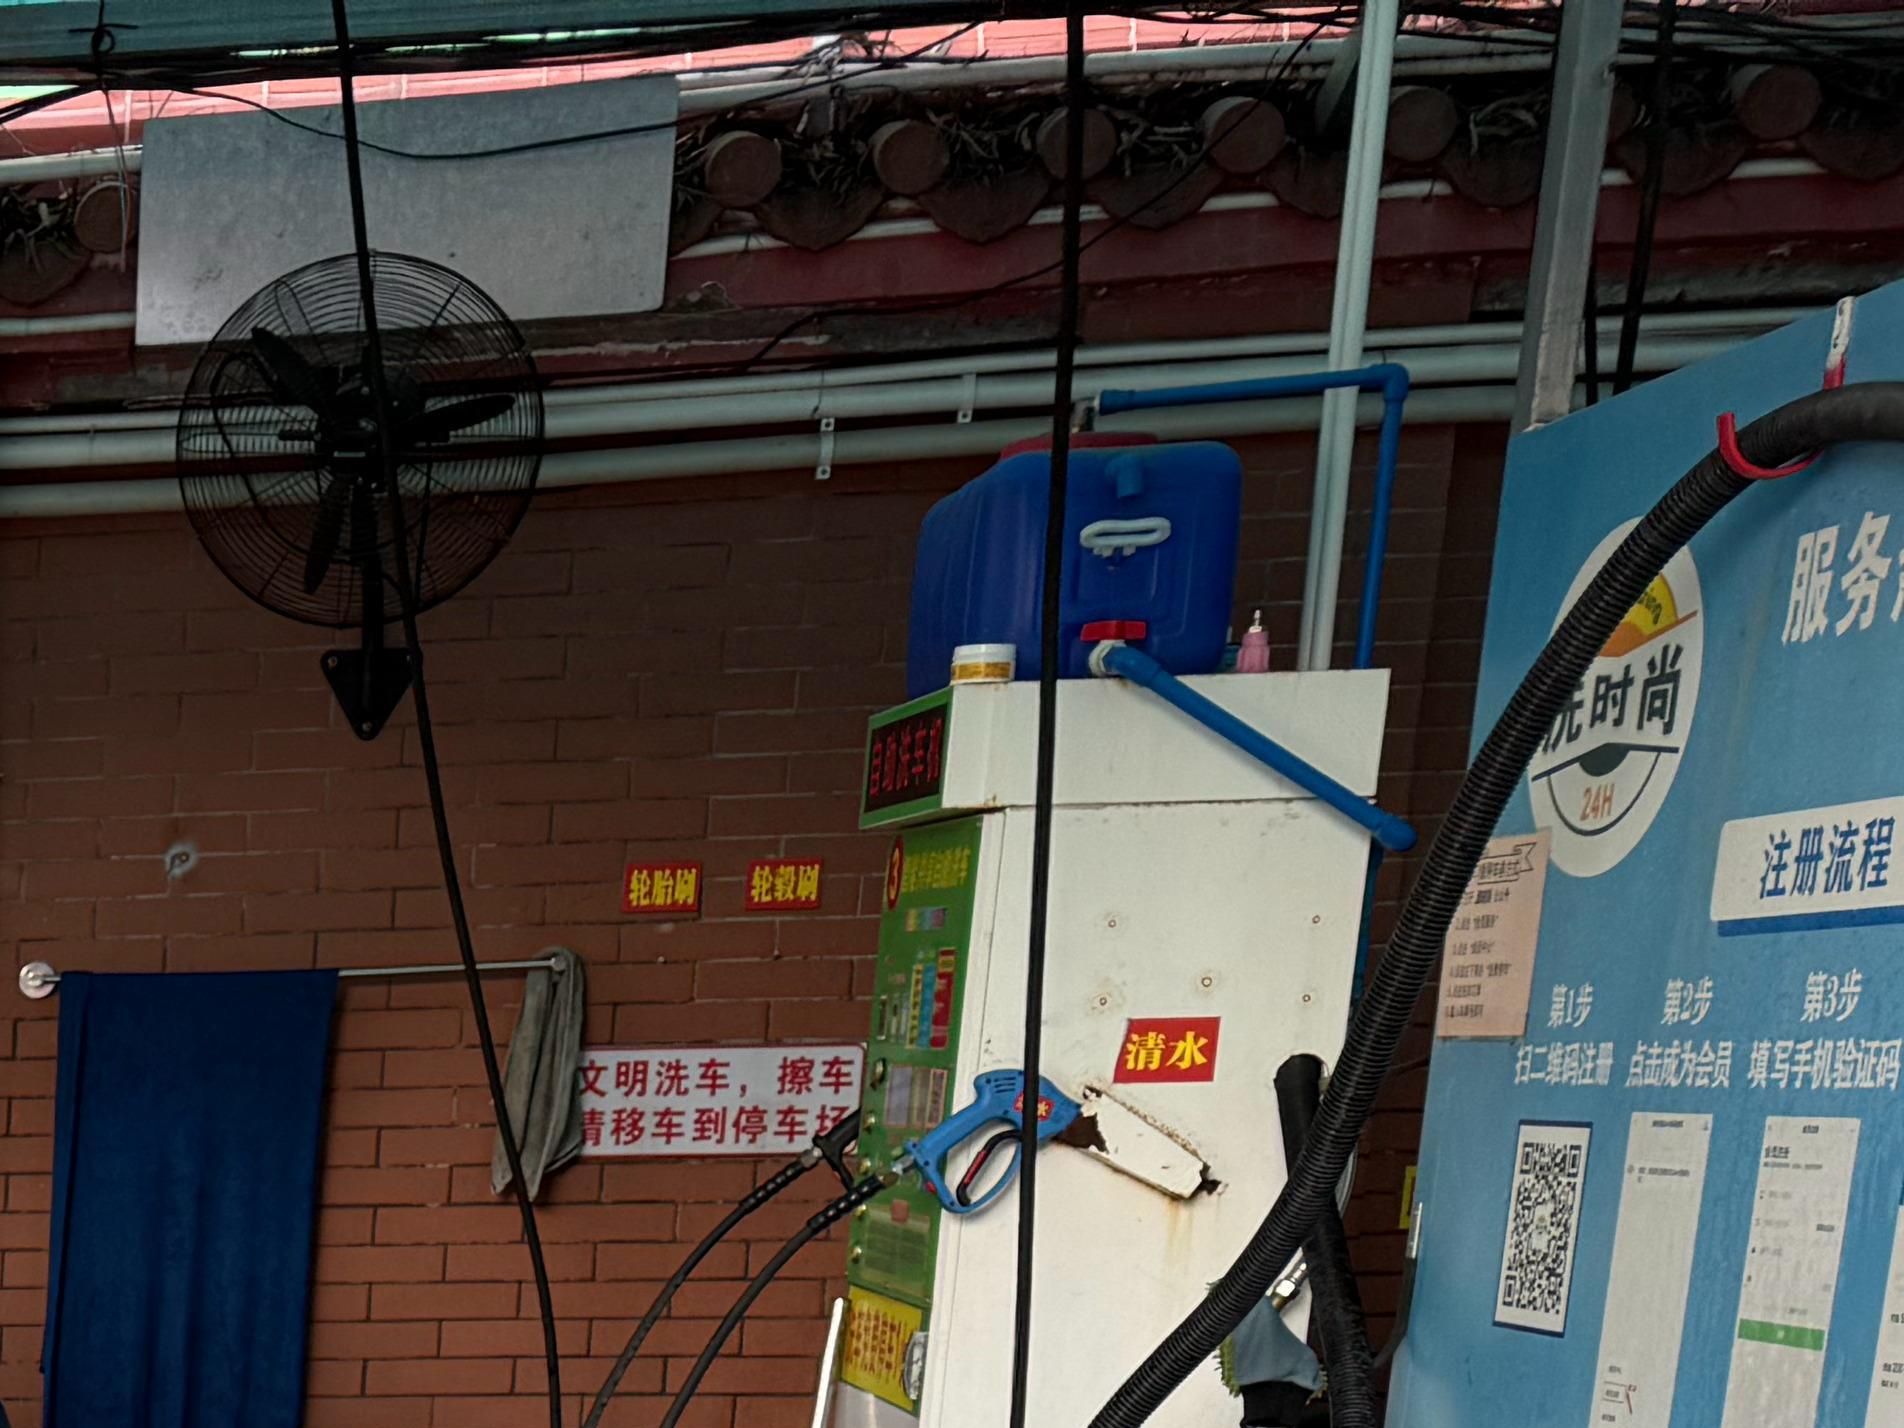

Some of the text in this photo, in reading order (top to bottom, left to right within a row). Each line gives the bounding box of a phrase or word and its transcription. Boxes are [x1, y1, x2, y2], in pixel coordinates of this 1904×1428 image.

[1580, 783, 1615, 821] 24H
[1759, 817, 1895, 900] 注册流程
[629, 868, 696, 906] 轮胎刷
[1547, 982, 1594, 1028] 第1步
[1660, 977, 1713, 1026] 第2步
[1800, 968, 1863, 1023] 第3步
[1126, 1031, 1208, 1071] 清水
[1514, 1040, 1613, 1087] 扫二维码注册
[1625, 1040, 1732, 1088] 点击成为会员
[1748, 1038, 1902, 1091] 填写手机验证码
